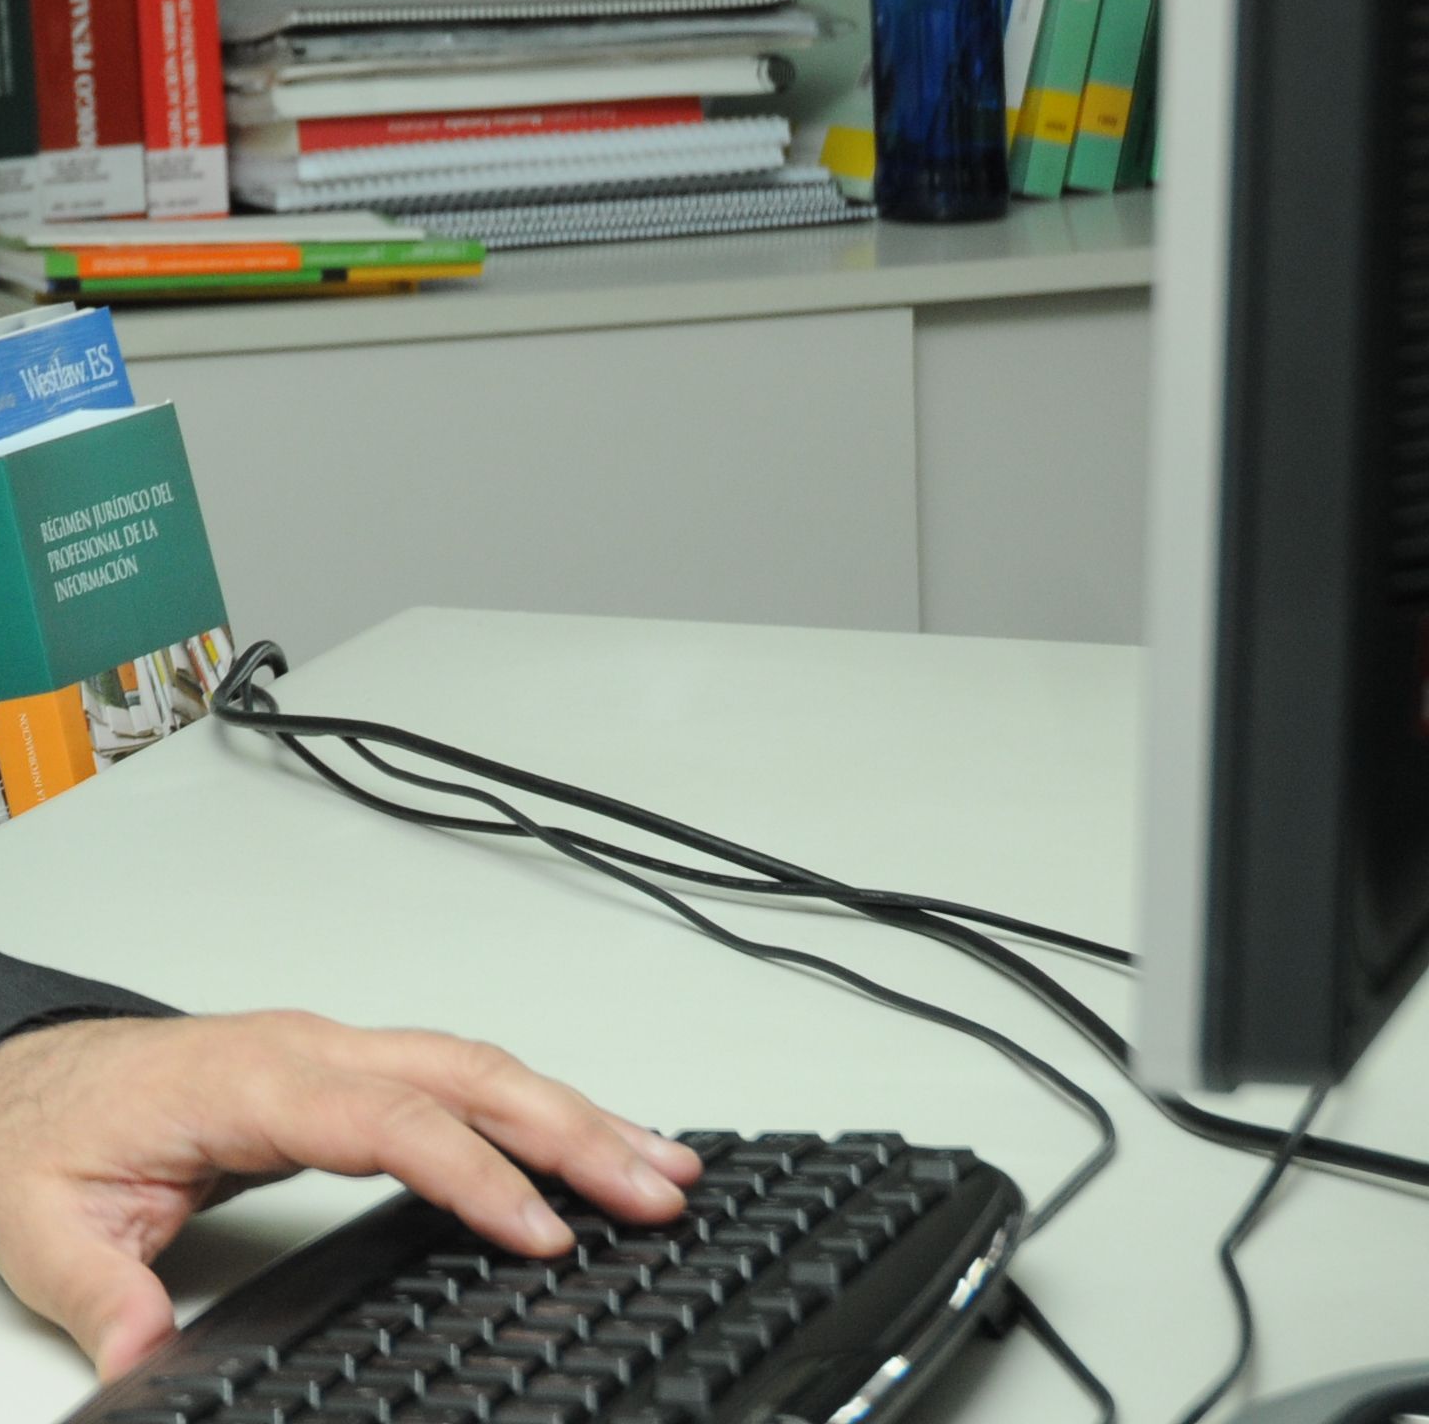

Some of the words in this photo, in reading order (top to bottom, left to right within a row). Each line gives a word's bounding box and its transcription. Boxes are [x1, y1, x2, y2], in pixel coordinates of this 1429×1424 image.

[40, 508, 92, 544] RÉGIMEN
[92, 488, 151, 531] JURÍDICO
[150, 481, 174, 508] DEL
[47, 527, 123, 573] PROFESIONAL
[123, 522, 142, 547] DE
[142, 517, 159, 543] LA
[54, 552, 139, 603] INFORMACIÓN
